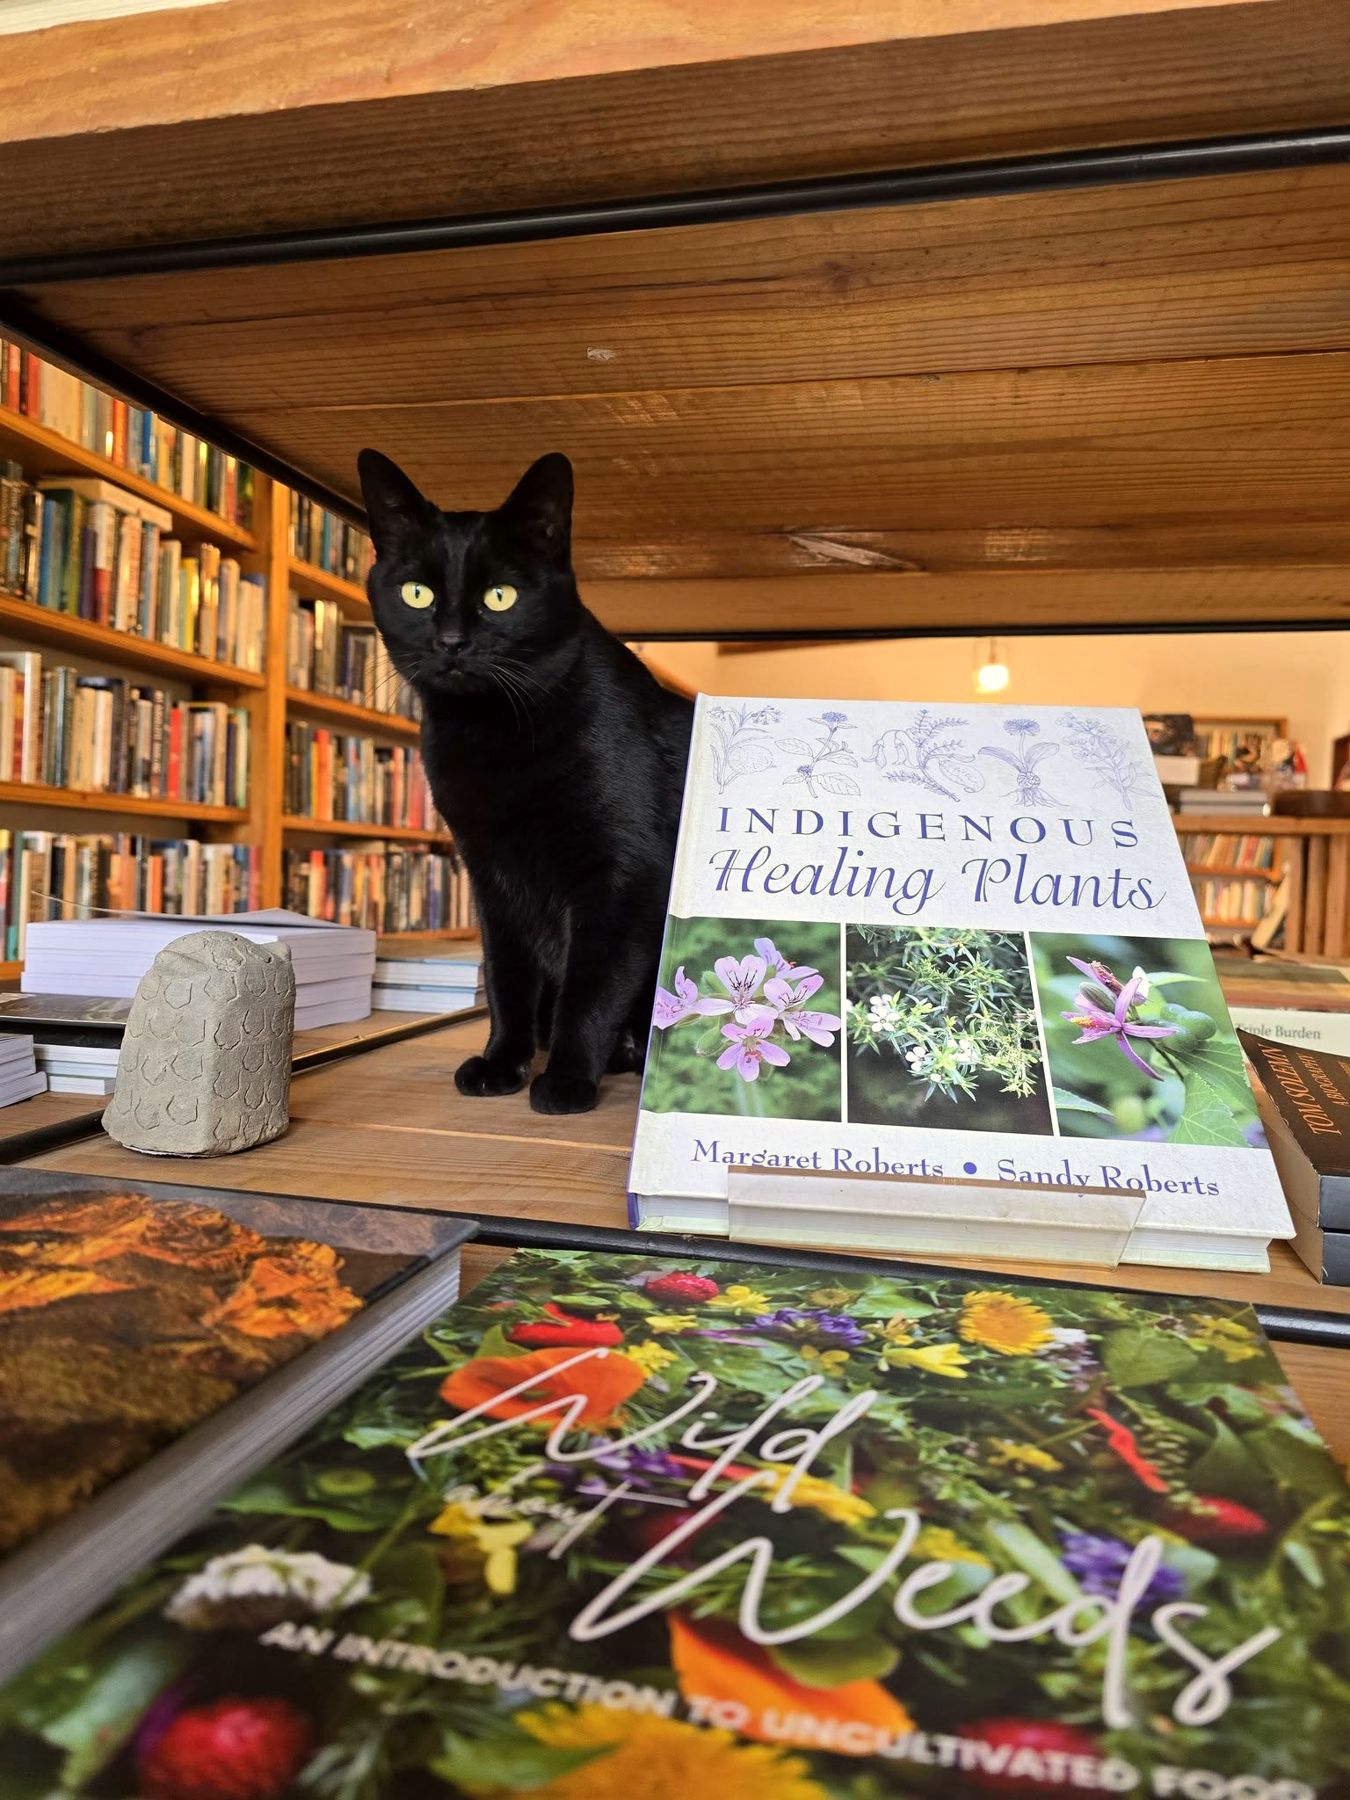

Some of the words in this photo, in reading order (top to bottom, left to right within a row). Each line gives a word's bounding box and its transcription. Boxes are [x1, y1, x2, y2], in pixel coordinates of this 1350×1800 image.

[715, 806, 1140, 849] INDIGENOUS
[708, 845, 946, 916] Healing
[960, 852, 1167, 911] Plants
[1275, 1024, 1321, 1040] Burden
[1292, 1099, 1342, 1135] TOM
[690, 1139, 822, 1169] Margaret
[831, 1147, 943, 1177] Roberts
[997, 1158, 1091, 1197] Sandy
[1098, 1164, 1220, 1196] Roberts
[405, 1347, 878, 1514] Wild
[568, 1470, 1282, 1728] Weeds
[258, 1621, 335, 1655] AN
[333, 1632, 677, 1718] INTRODUCTION
[687, 1694, 751, 1731] TO
[760, 1708, 1141, 1793] UNCULTIVATED
[1150, 1763, 1318, 1800] FOOD
